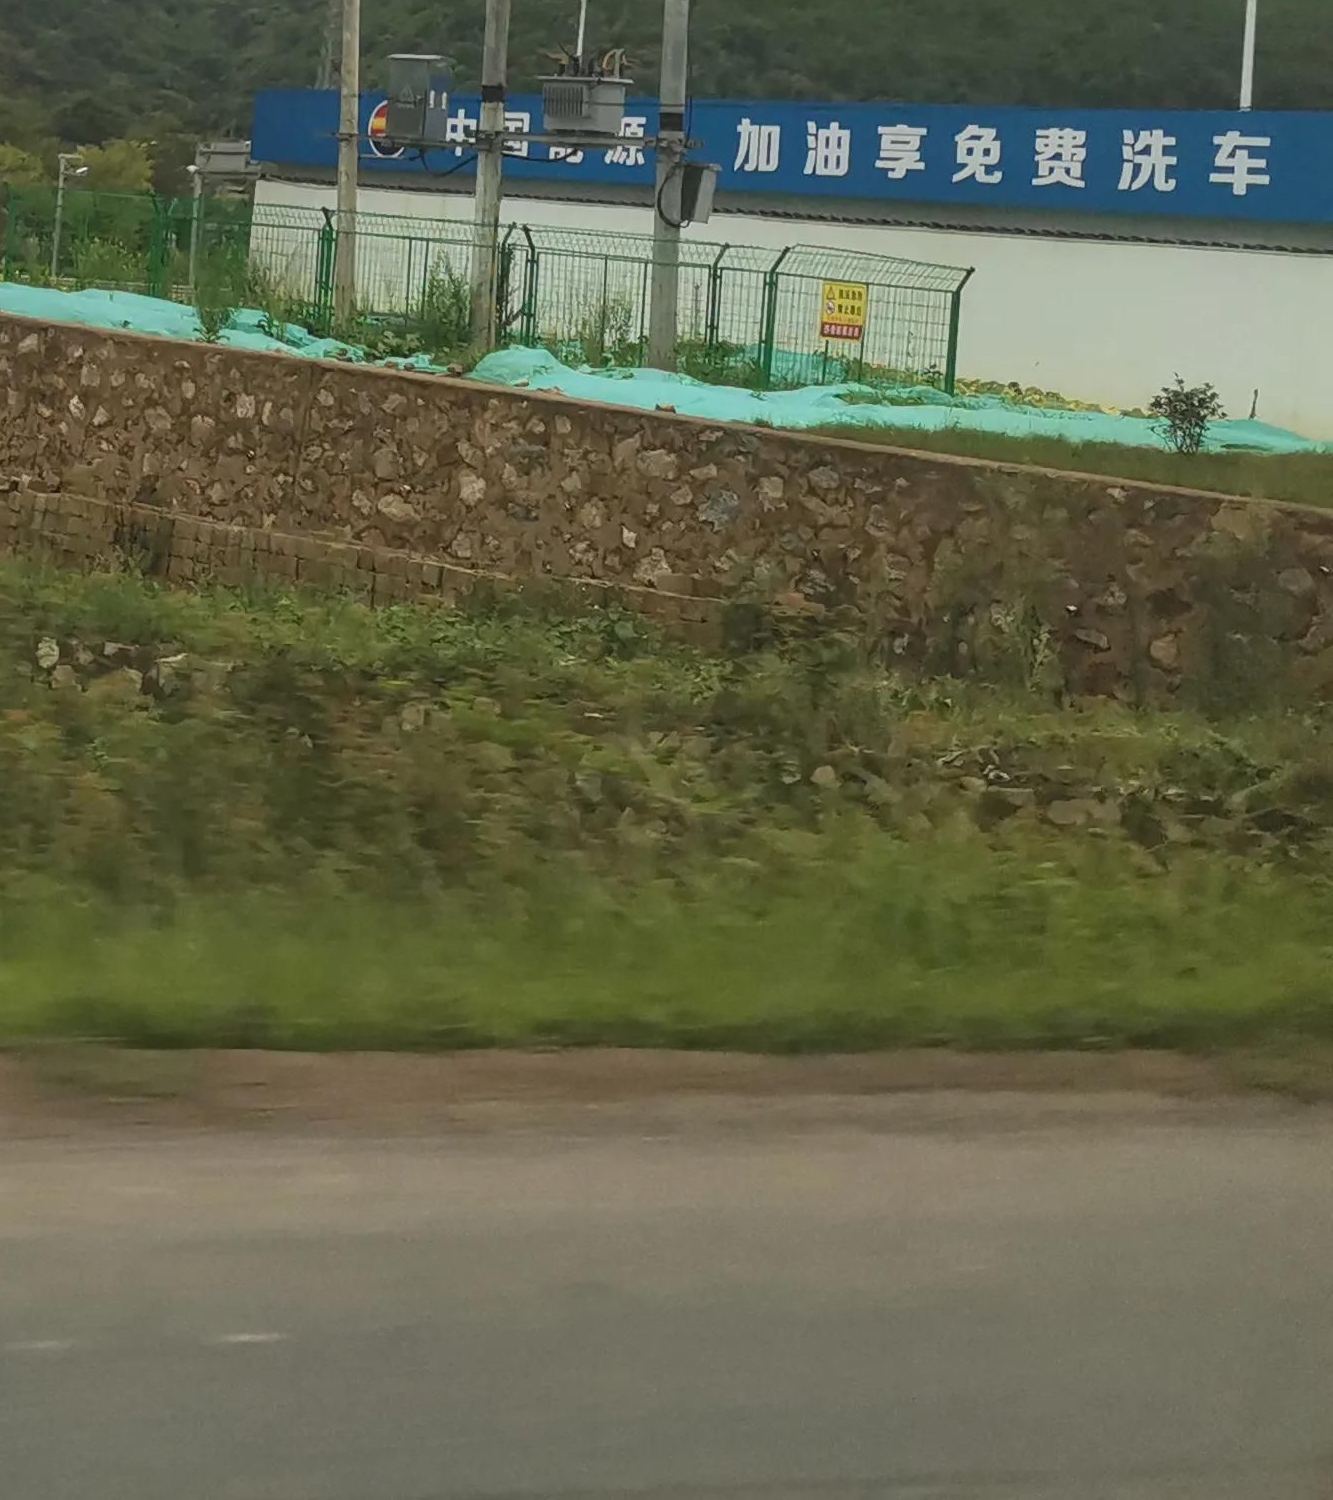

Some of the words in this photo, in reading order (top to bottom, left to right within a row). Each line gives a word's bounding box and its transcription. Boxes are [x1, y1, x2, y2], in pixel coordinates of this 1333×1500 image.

[733, 117, 1271, 196] 加油享免费洗车
